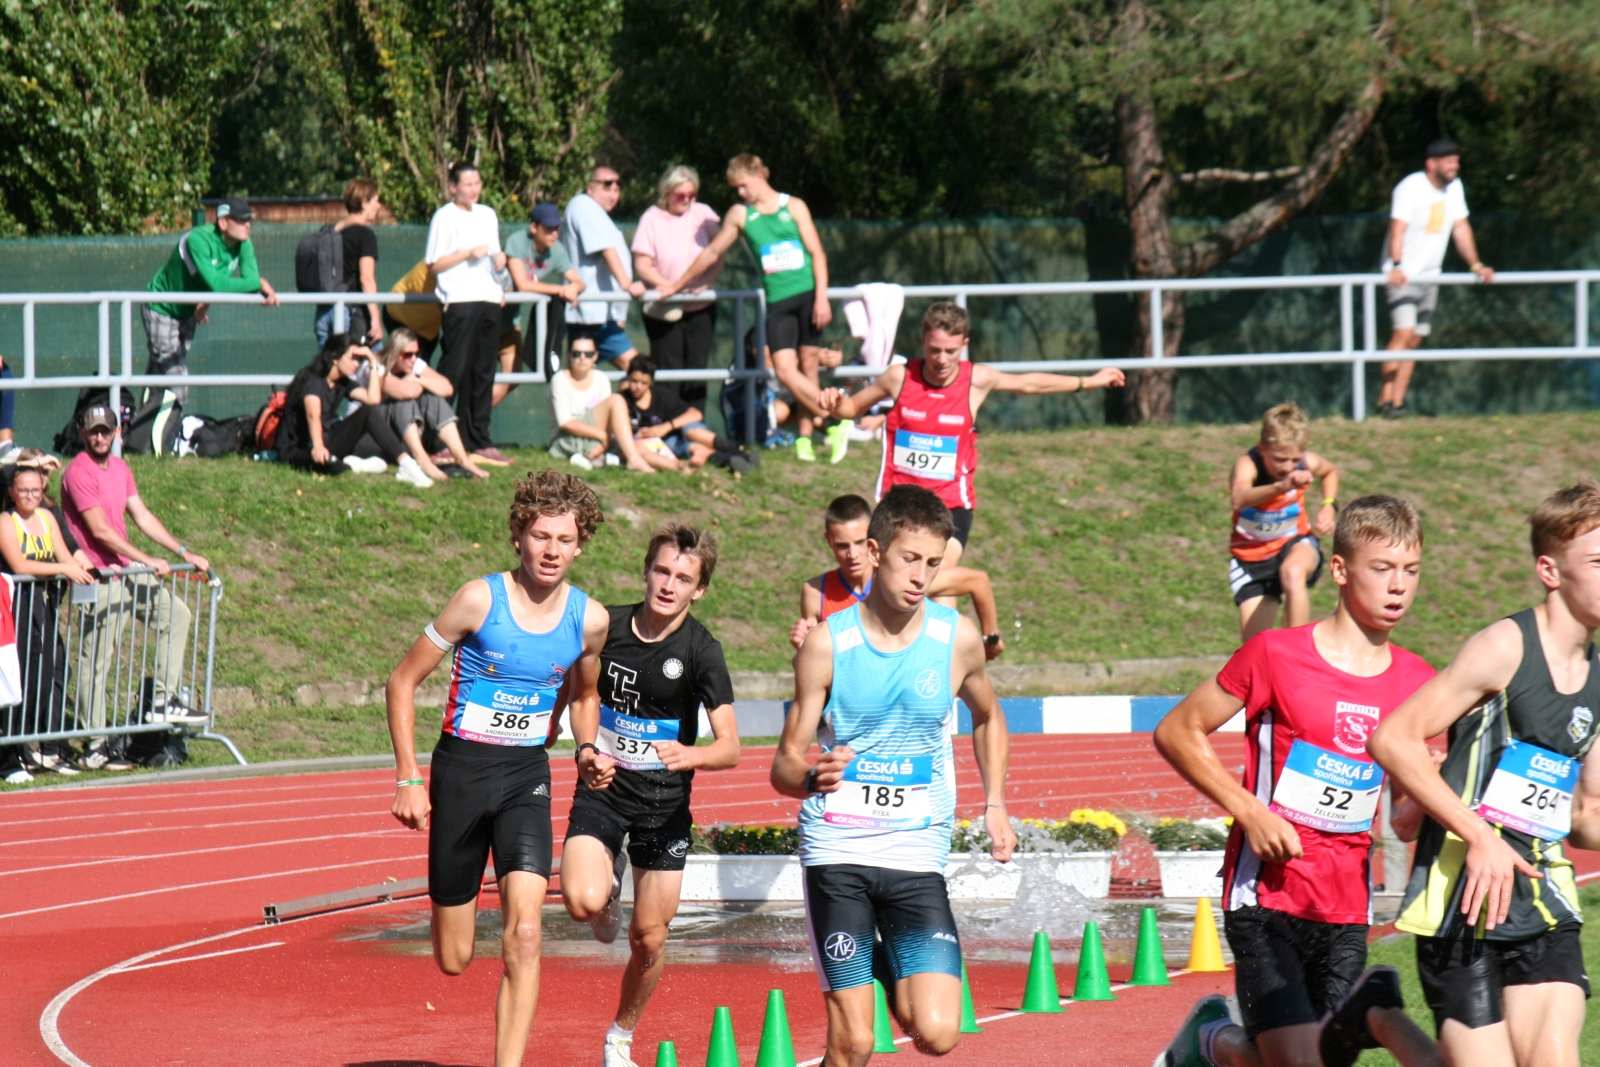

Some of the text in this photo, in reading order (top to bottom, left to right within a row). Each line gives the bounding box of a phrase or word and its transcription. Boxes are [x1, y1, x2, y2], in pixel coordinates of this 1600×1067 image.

[906, 452, 942, 470] 497
[491, 701, 523, 711] spořitelna
[493, 689, 528, 706] ČESKÁ
[1340, 703, 1376, 715] ATLETIKA
[490, 712, 531, 730] 586
[615, 716, 645, 733] ČESKÁ
[615, 726, 642, 738] spořitelna
[615, 736, 652, 755] 537
[620, 753, 645, 762] JEDLIČKA
[856, 758, 899, 775] ČESKÁ
[1316, 753, 1361, 780] ČESKÁ
[856, 773, 894, 783] spořitelna
[1312, 768, 1353, 787] spořitelna
[861, 785, 905, 808] 185
[1318, 786, 1354, 810] 52
[1520, 783, 1560, 814] 264
[872, 809, 890, 817] RYBA
[1293, 810, 1322, 827] ŽACTVA
[1313, 807, 1348, 820] ŽELEZNÍK
